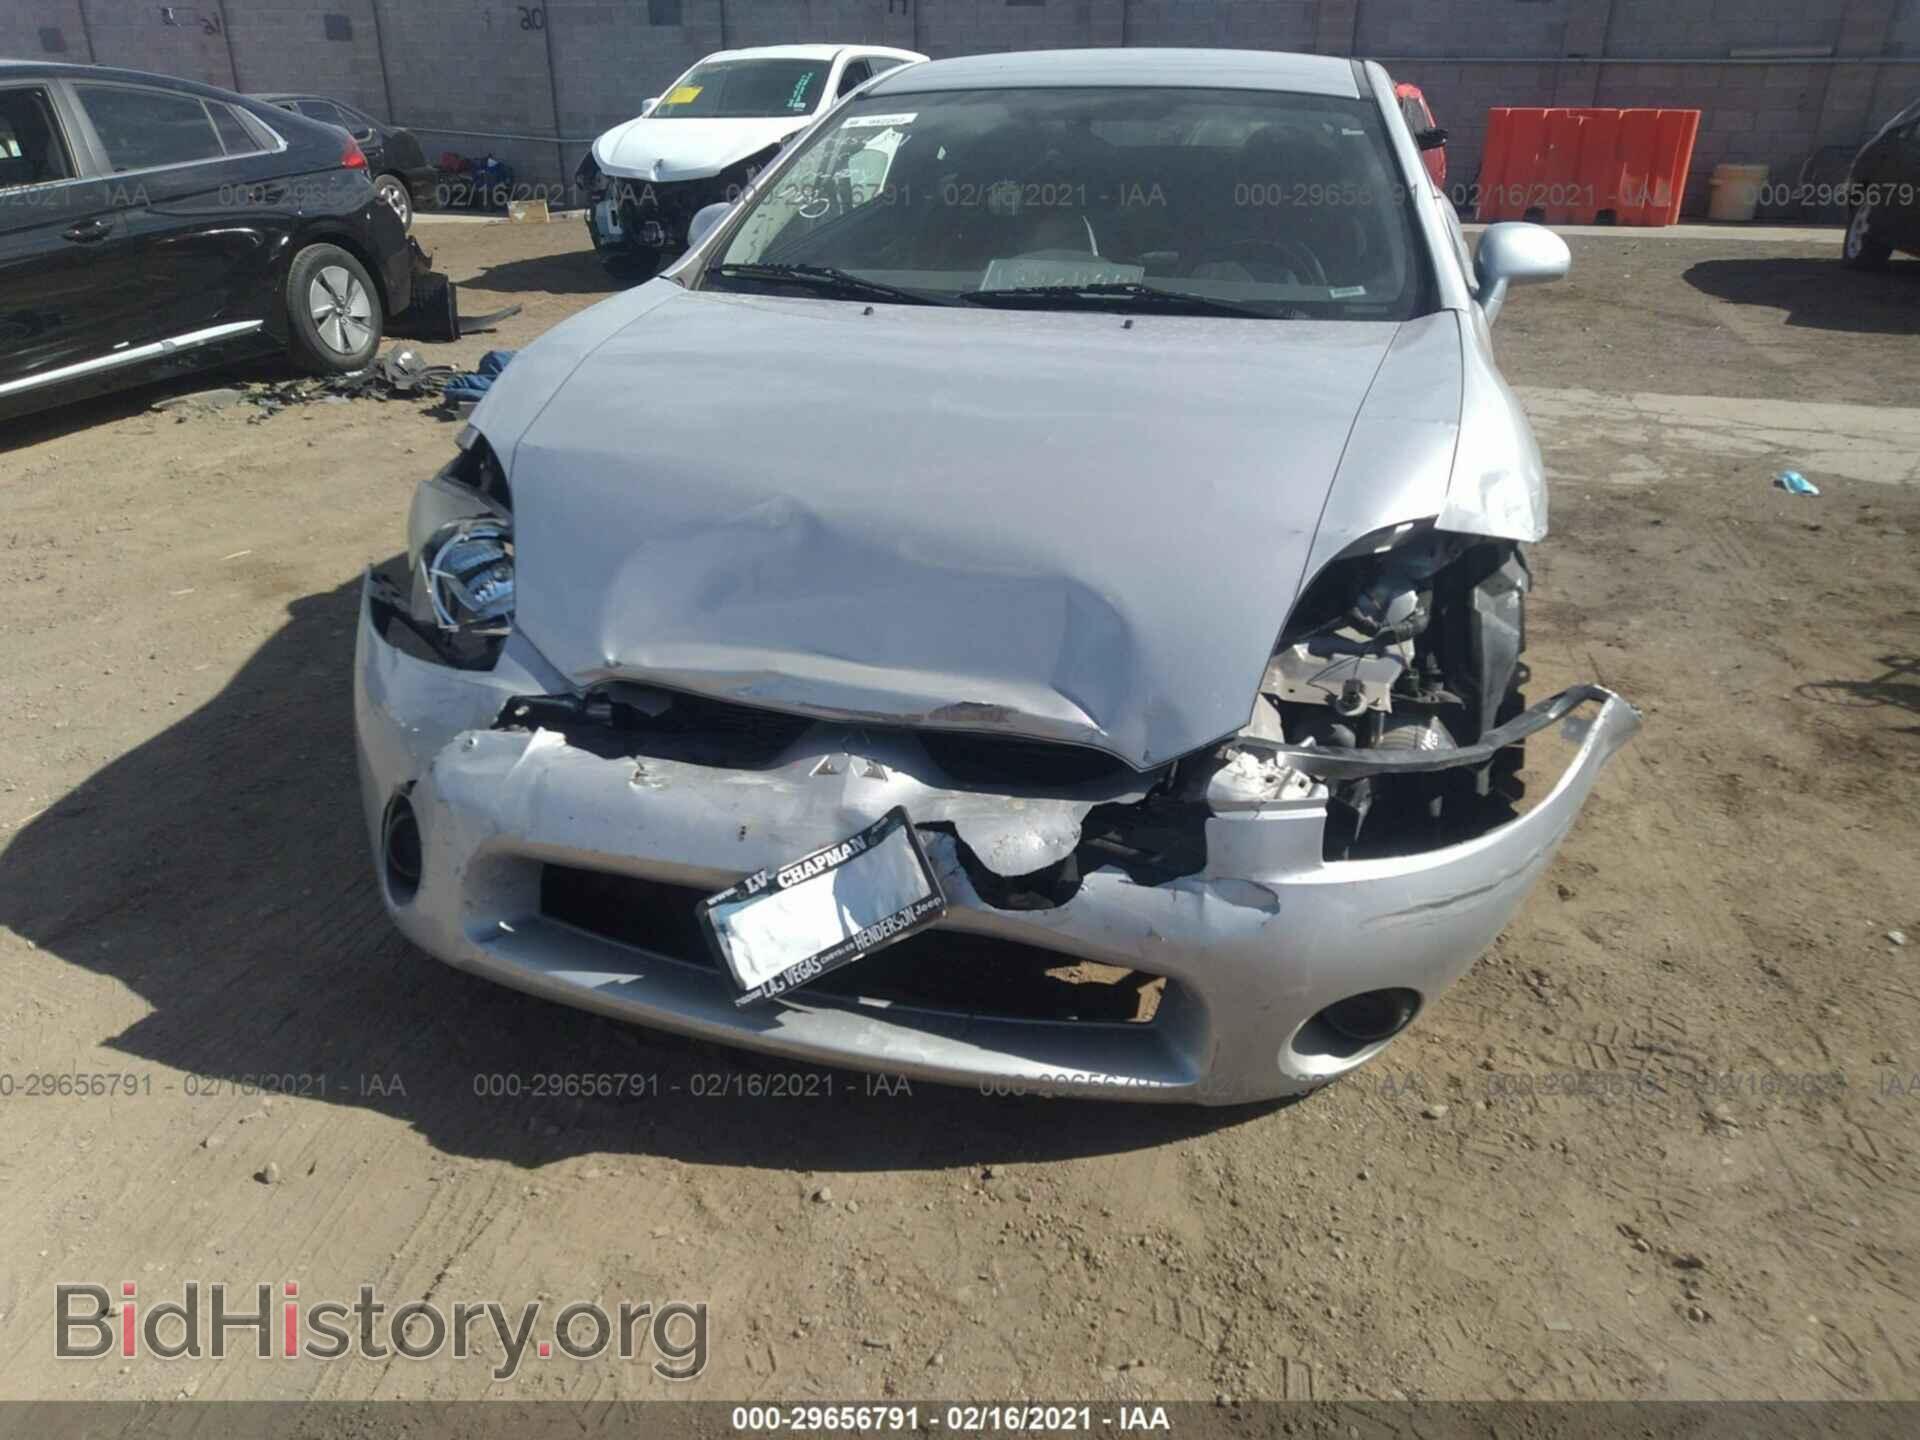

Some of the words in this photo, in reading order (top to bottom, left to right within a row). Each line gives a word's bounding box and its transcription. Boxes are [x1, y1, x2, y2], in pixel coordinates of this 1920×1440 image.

[745, 869, 768, 894] LV
[777, 836, 867, 889] CHAPMAN
[784, 956, 822, 987] VEGAS
[853, 906, 918, 951] HENDERSON
[916, 897, 942, 915] Jeep
